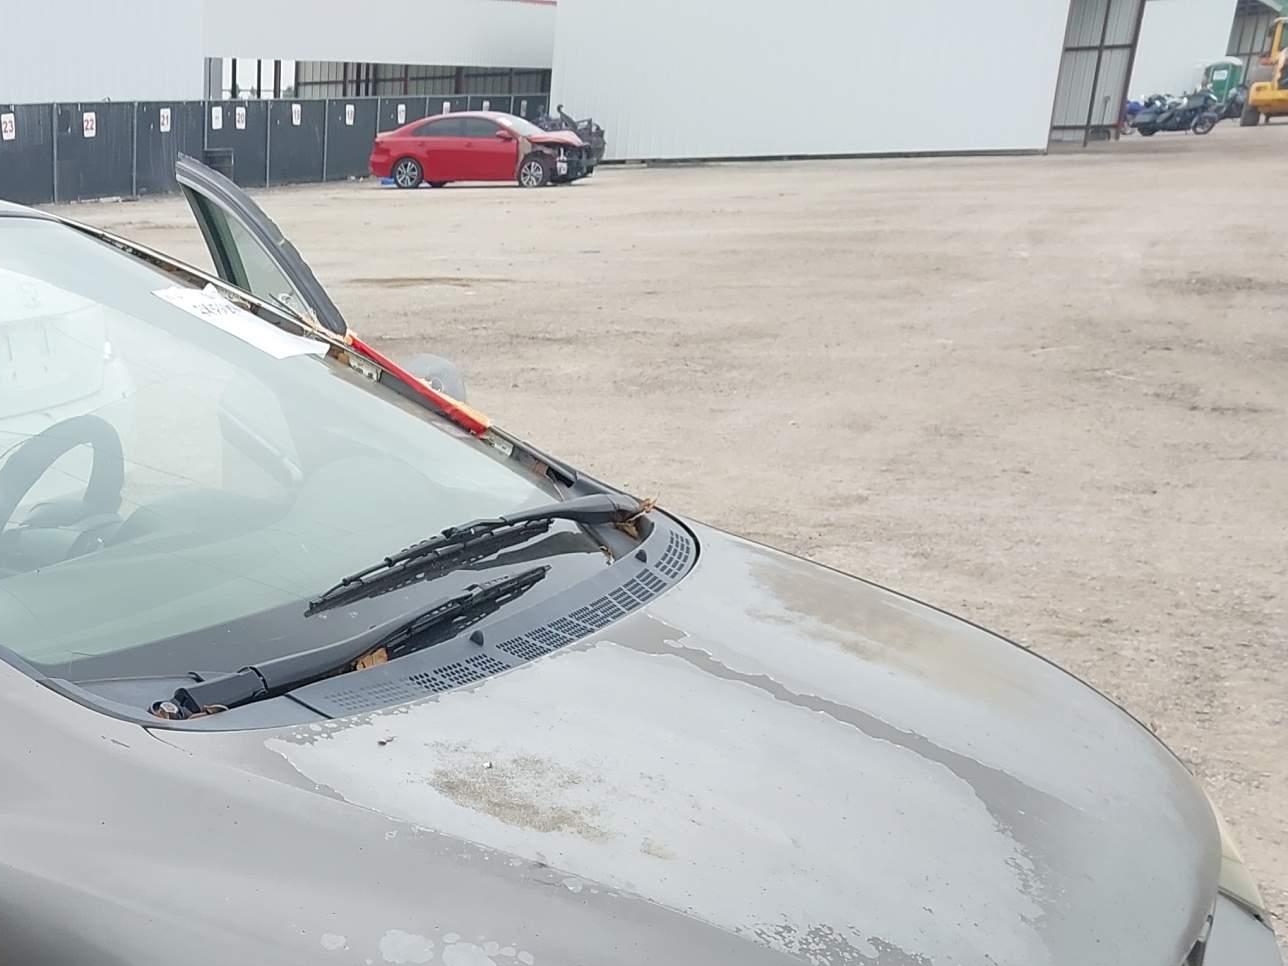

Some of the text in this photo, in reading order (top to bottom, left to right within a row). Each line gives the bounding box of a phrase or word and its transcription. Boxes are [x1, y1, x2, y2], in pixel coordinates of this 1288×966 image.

[237, 112, 245, 124] 20
[2, 120, 14, 134] 23
[84, 119, 95, 131] 22
